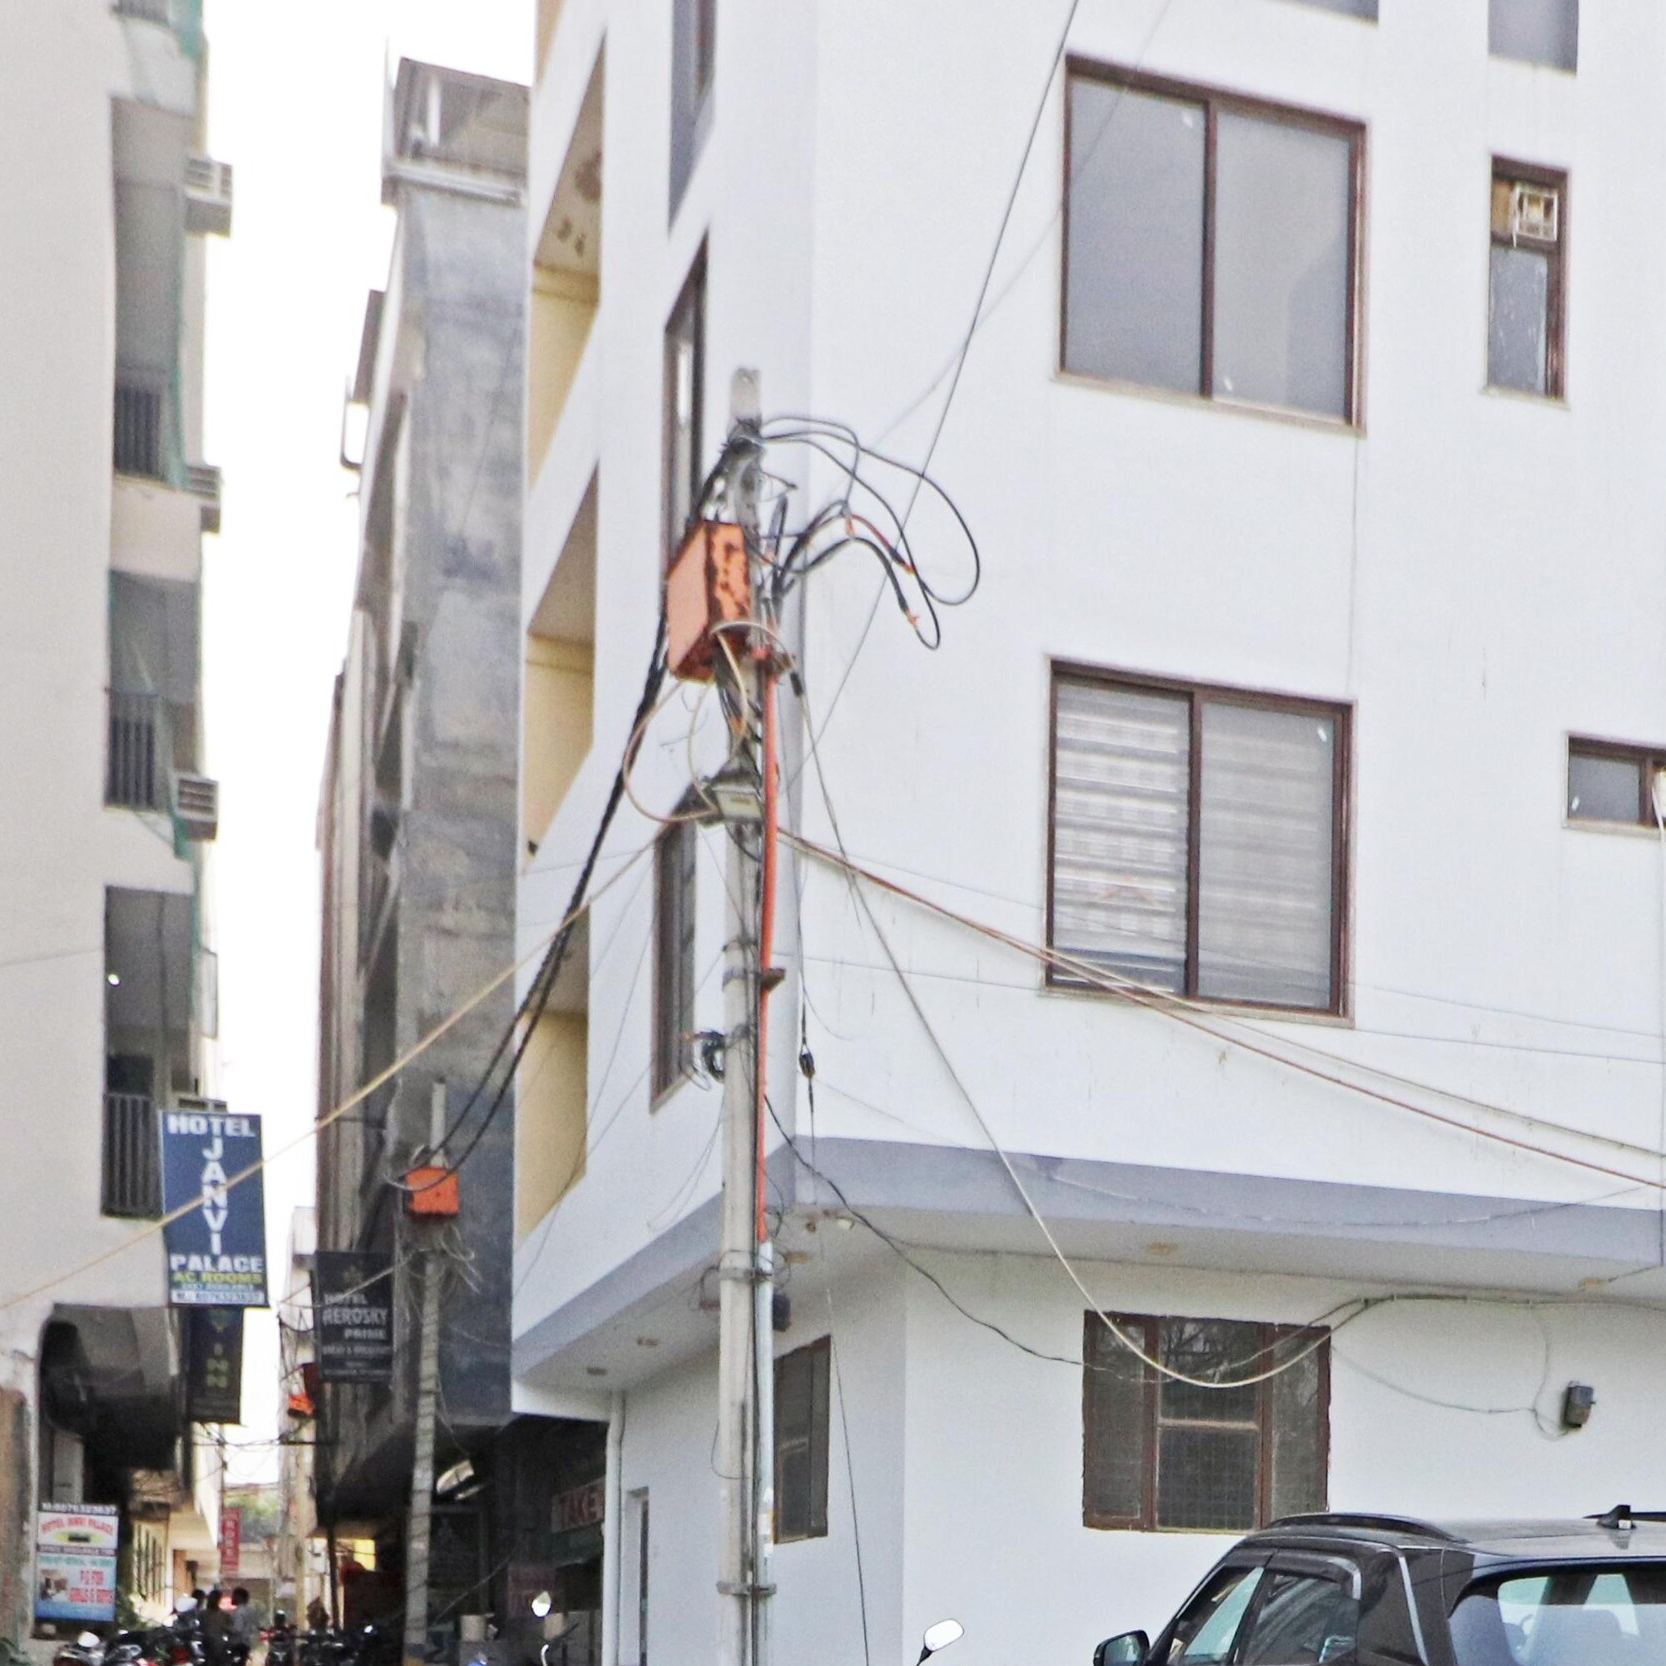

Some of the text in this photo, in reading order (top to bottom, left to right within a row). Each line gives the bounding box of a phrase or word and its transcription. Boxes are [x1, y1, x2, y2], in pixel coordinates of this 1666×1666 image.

[167, 1115, 255, 1137] HOTEL
[201, 1137, 228, 1255] JANVI
[170, 1254, 264, 1272] PALACE
[200, 1272, 263, 1283] ROOMS
